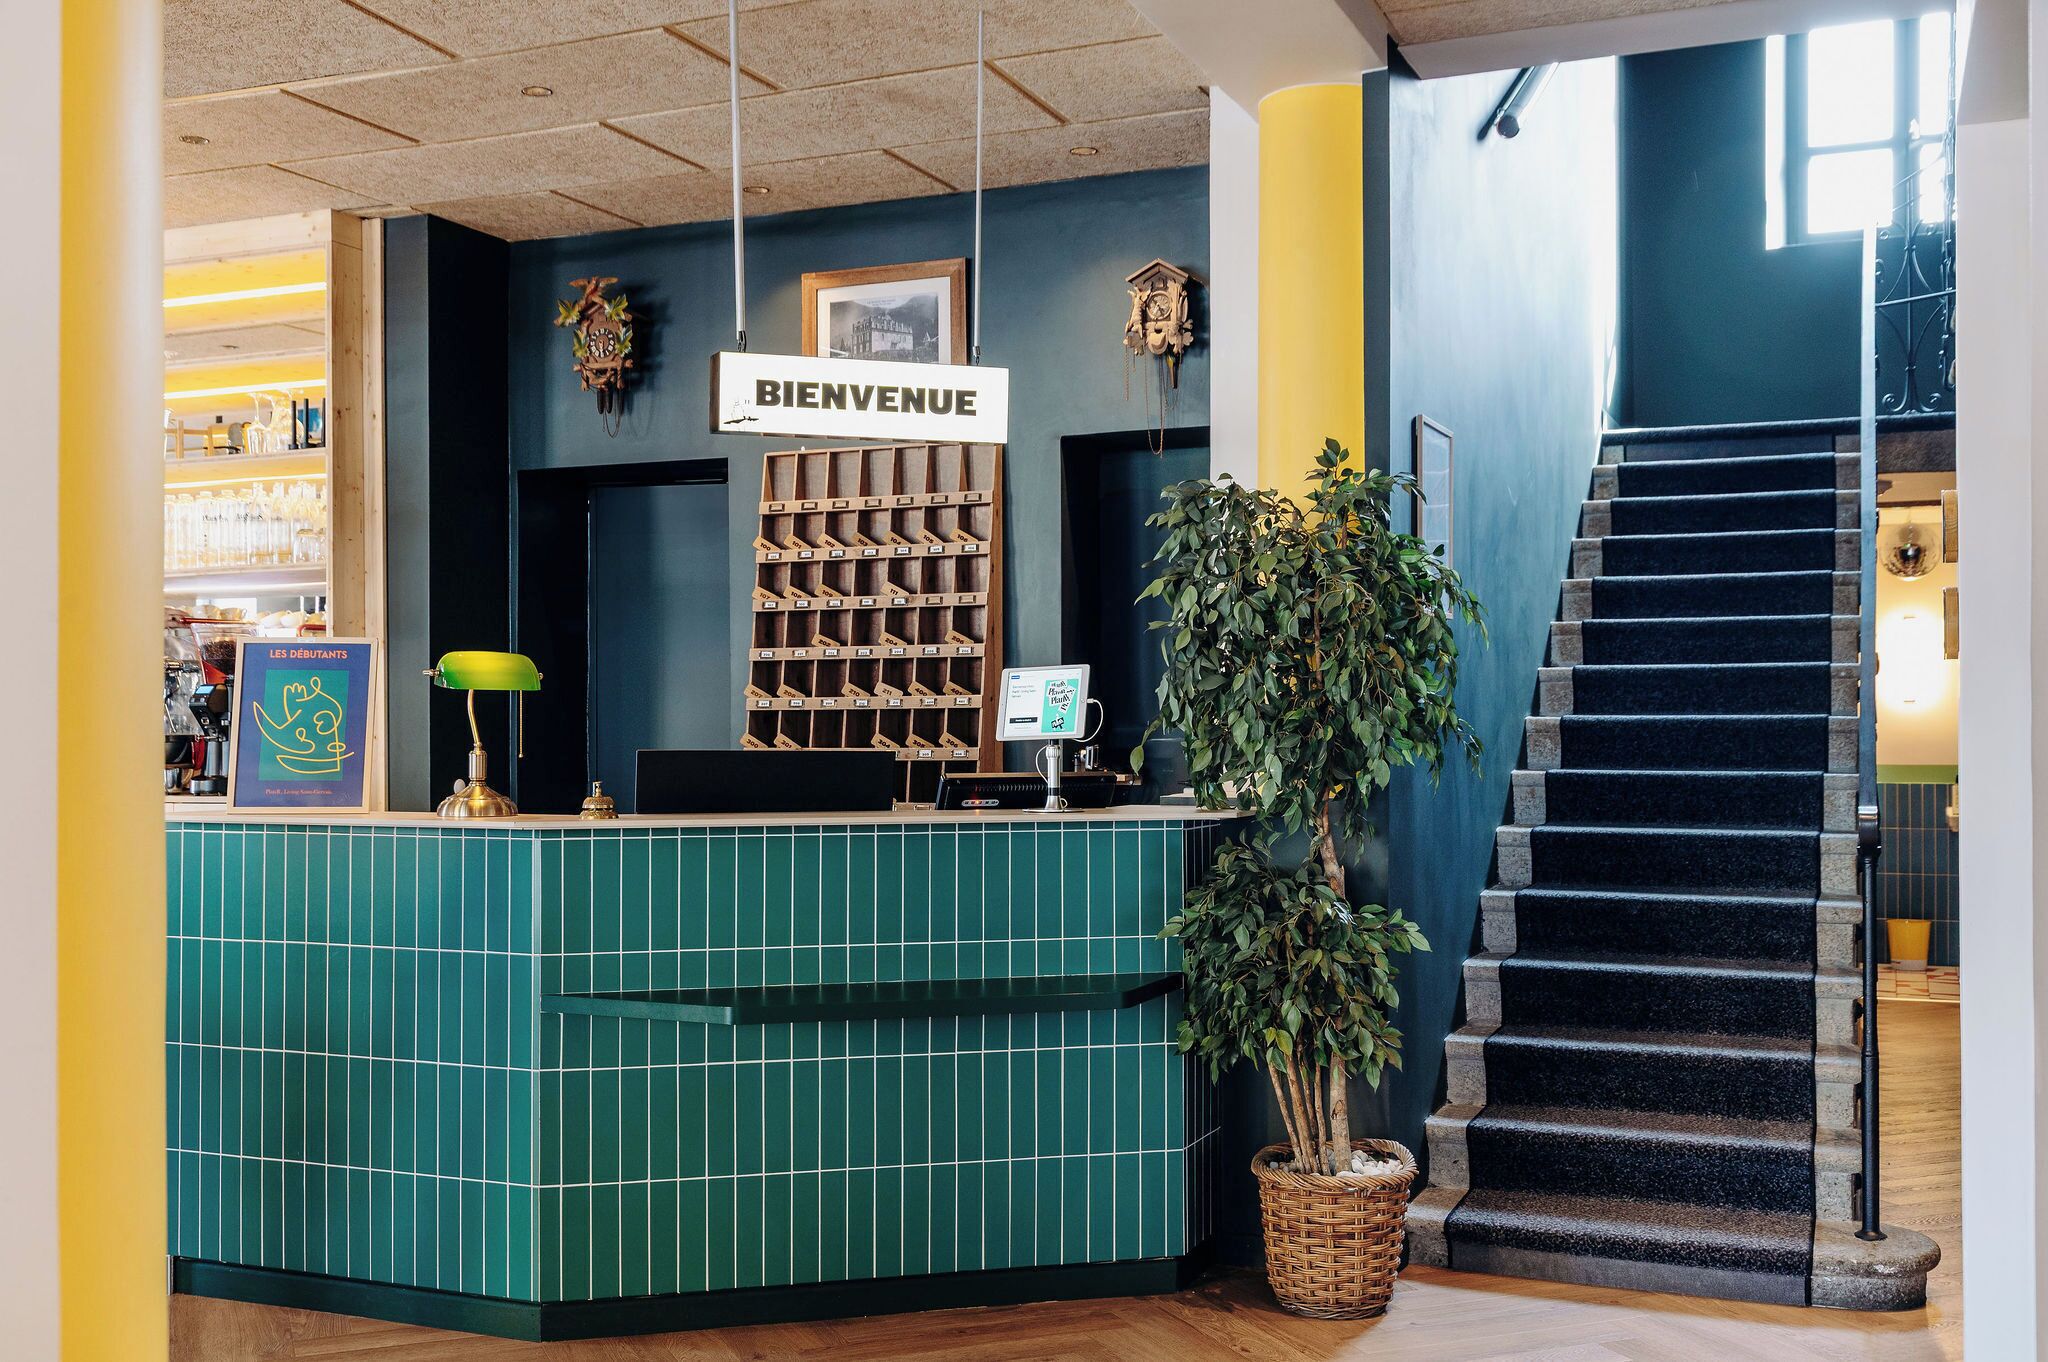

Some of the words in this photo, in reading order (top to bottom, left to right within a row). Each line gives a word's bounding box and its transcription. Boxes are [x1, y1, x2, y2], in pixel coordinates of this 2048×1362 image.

[756, 379, 977, 417] BIENVENUE
[890, 537, 901, 545] 104
[923, 534, 934, 544] 105
[957, 533, 968, 543] 106
[760, 542, 771, 551] 100
[792, 540, 802, 549] 101
[824, 539, 835, 548] 102
[759, 592, 771, 600] 107
[822, 589, 834, 598] 109
[889, 588, 898, 596] 111
[818, 638, 831, 647] 202
[269, 649, 287, 658] LES
[289, 647, 348, 659] DÉBUTANTS
[750, 689, 763, 698] 207
[848, 688, 861, 697] 210
[882, 687, 893, 696] 211
[914, 687, 928, 696] 400
[746, 738, 759, 748] 300
[780, 739, 792, 749] 301
[877, 738, 891, 748] 304
[945, 738, 958, 748] 306
